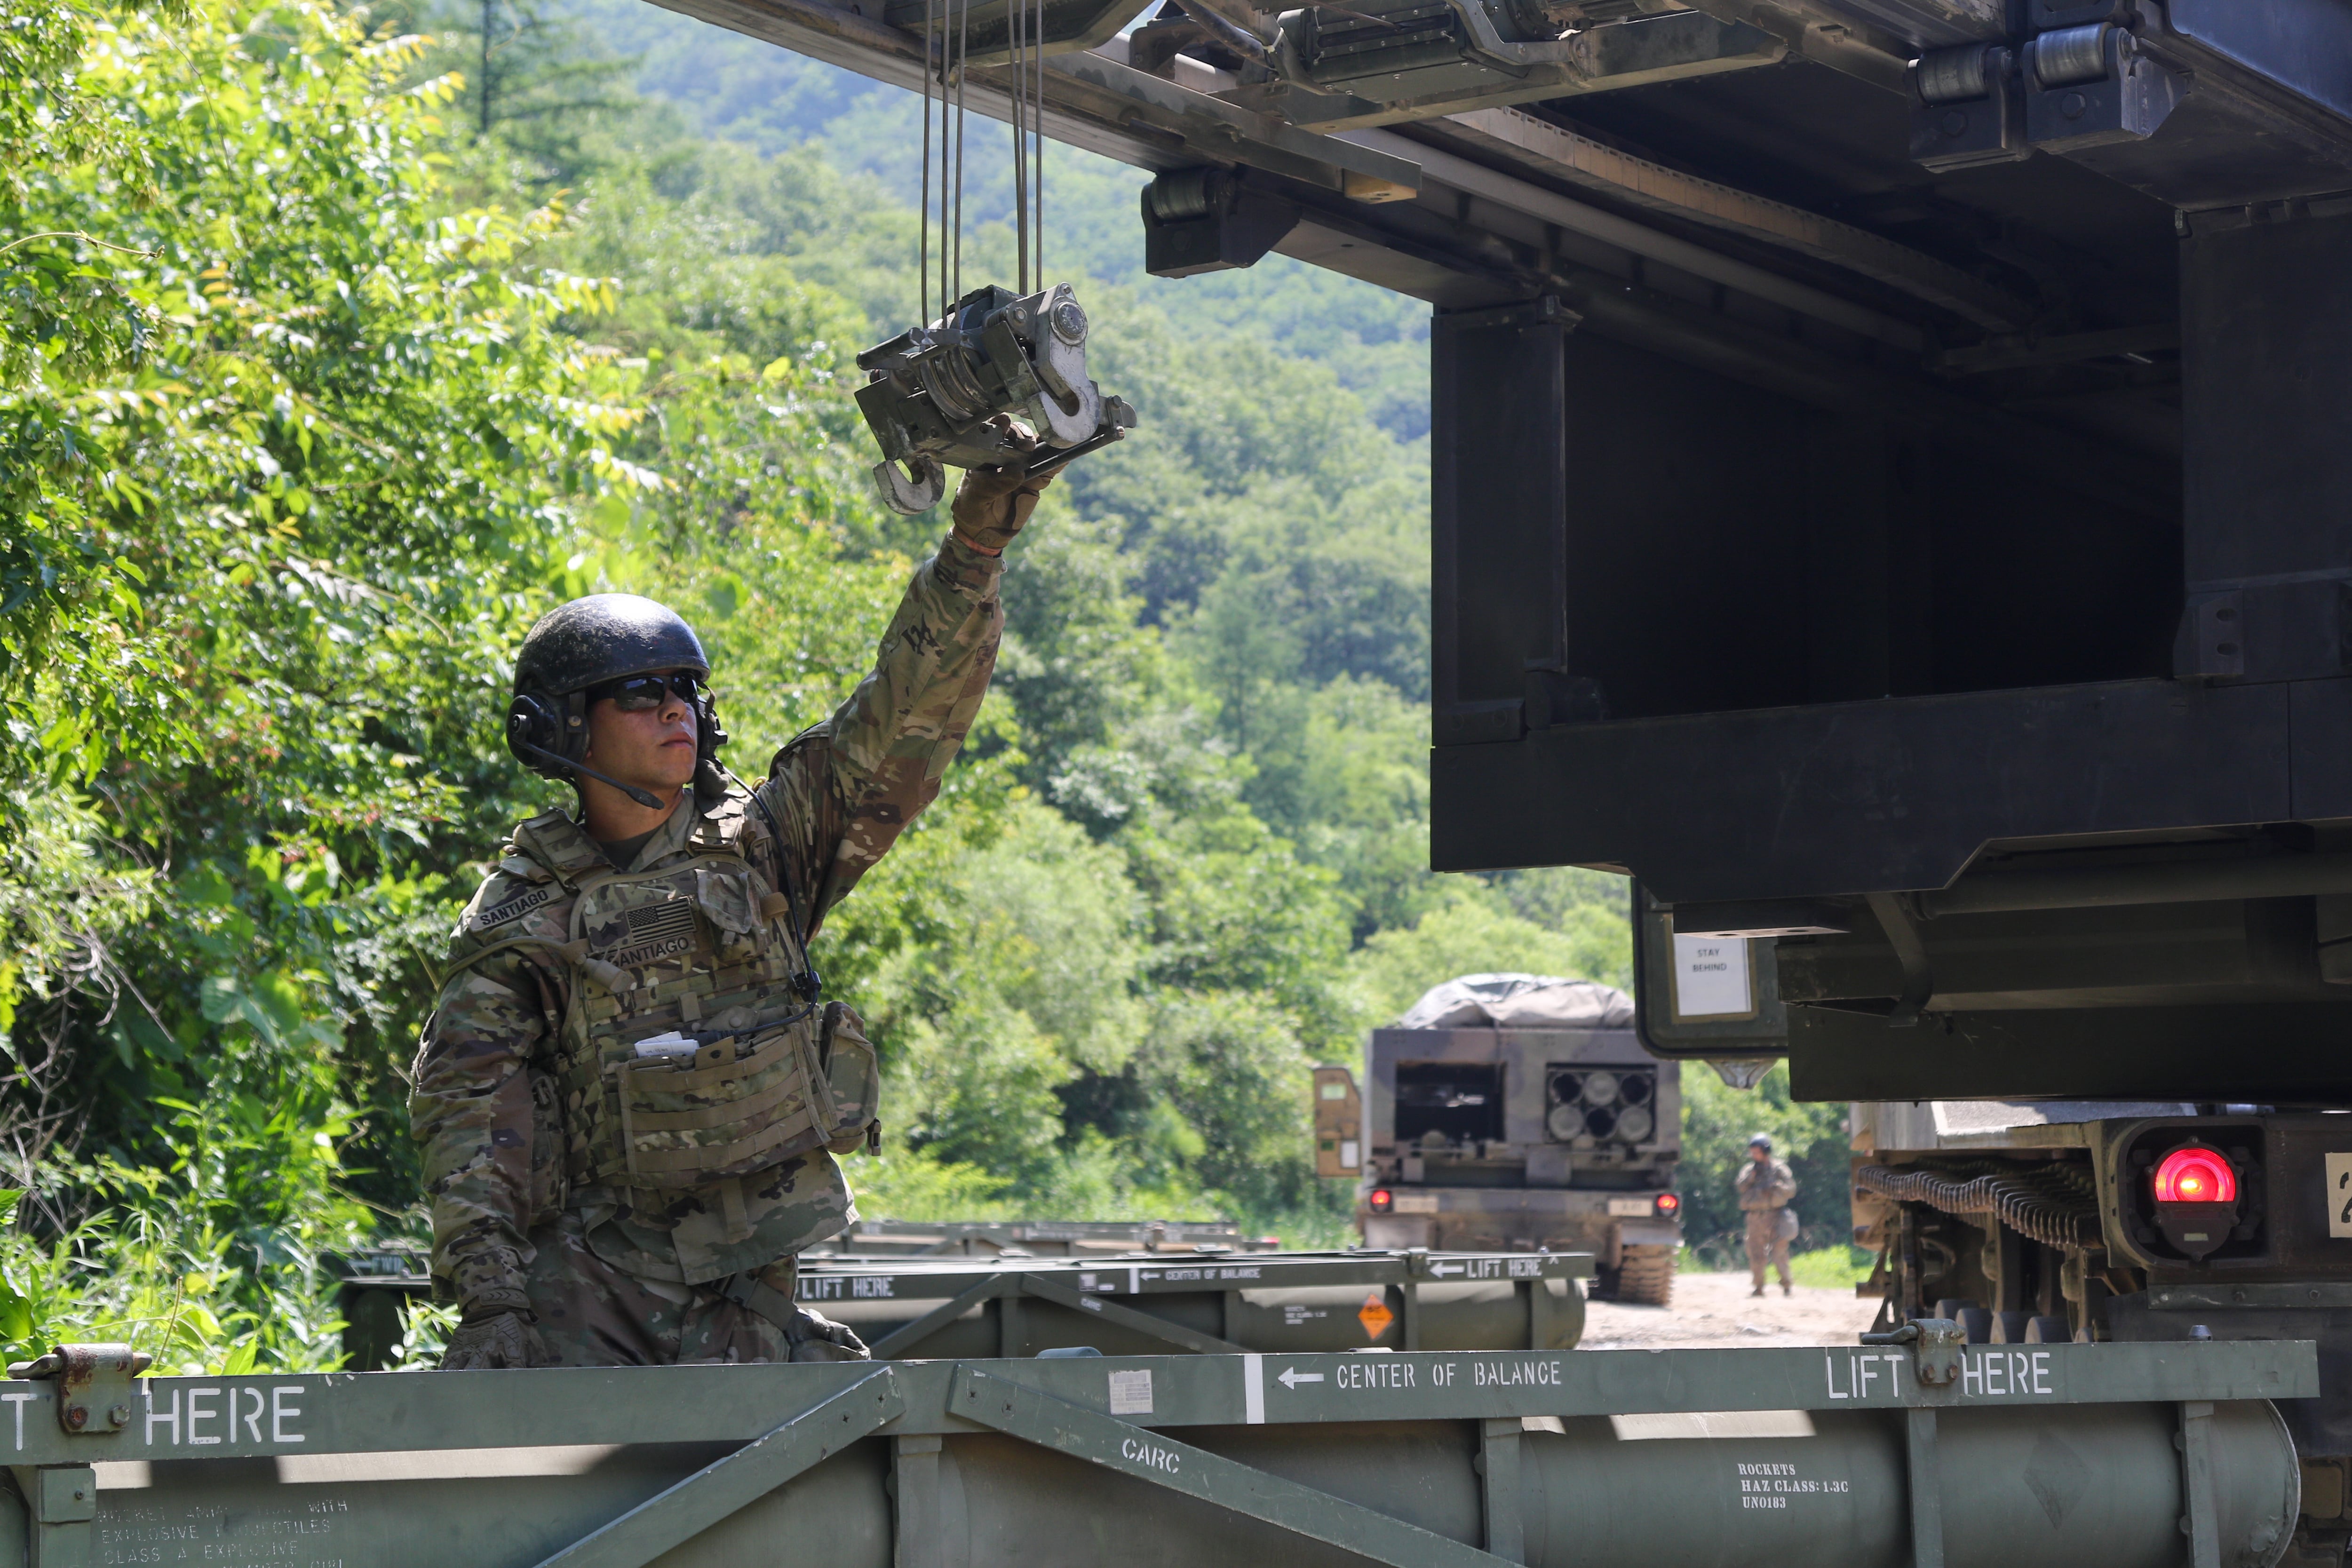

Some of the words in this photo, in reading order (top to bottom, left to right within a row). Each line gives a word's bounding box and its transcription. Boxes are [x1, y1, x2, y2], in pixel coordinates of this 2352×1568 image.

[480, 890, 548, 925] SANTIAGO
[607, 937, 689, 967] SANTIAGO
[1697, 948, 1720, 957] STAY
[1692, 963, 1727, 972] BEHIND
[1165, 1271, 1200, 1280] CENTER
[1204, 1270, 1216, 1279] OF
[1221, 1268, 1261, 1279] BALANCE
[1467, 1259, 1502, 1278] LIFT
[1508, 1258, 1542, 1277] HERE
[802, 1278, 844, 1299] LIFT
[853, 1276, 894, 1297] HERE
[1337, 1364, 1415, 1389] CENTER
[1432, 1363, 1456, 1386] OF
[1475, 1361, 1561, 1386] BALANCE
[1827, 1354, 1904, 1399] LIFT
[1960, 1352, 2053, 1395] HERE
[145, 1386, 305, 1445] HERE
[1122, 1439, 1180, 1474] CARC
[1738, 1464, 1796, 1475] ROCKETS
[1741, 1480, 1770, 1492] HAZ
[1774, 1480, 1819, 1492] CLASS:
[1823, 1481, 1848, 1492] 1.3C
[307, 1499, 348, 1513] WITH
[104, 1547, 161, 1564] CLASS
